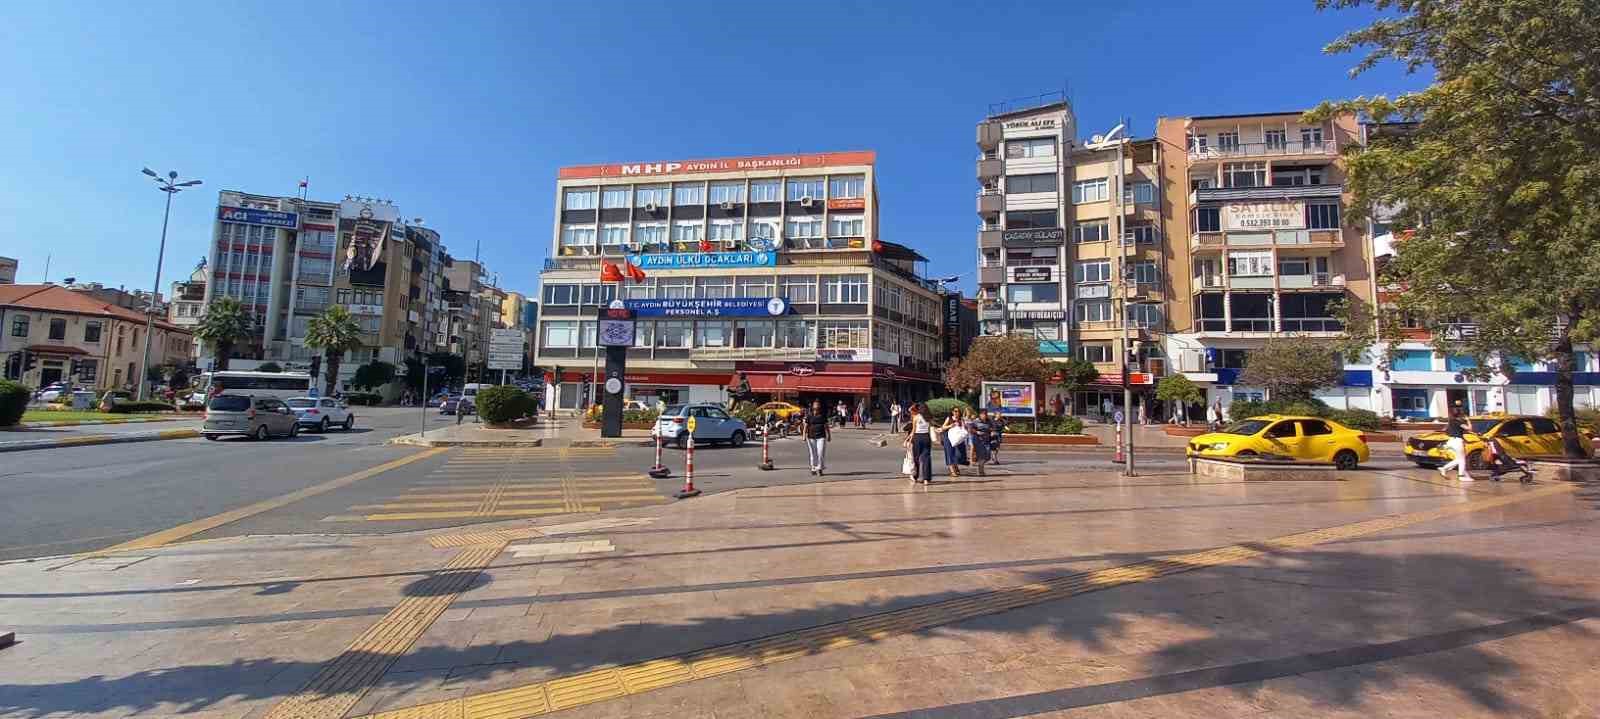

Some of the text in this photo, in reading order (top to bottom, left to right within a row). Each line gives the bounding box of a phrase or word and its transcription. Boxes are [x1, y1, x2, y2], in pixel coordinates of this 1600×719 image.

[622, 163, 681, 174] MHP
[687, 163, 717, 171] AYDIN
[737, 157, 801, 169] BAŞKANLIĞI
[647, 255, 673, 265] AYDIN
[705, 254, 753, 264] OCAKLARI
[662, 299, 723, 309] BÜYÜKŞEHİR
[665, 308, 704, 316] PERSONEL
